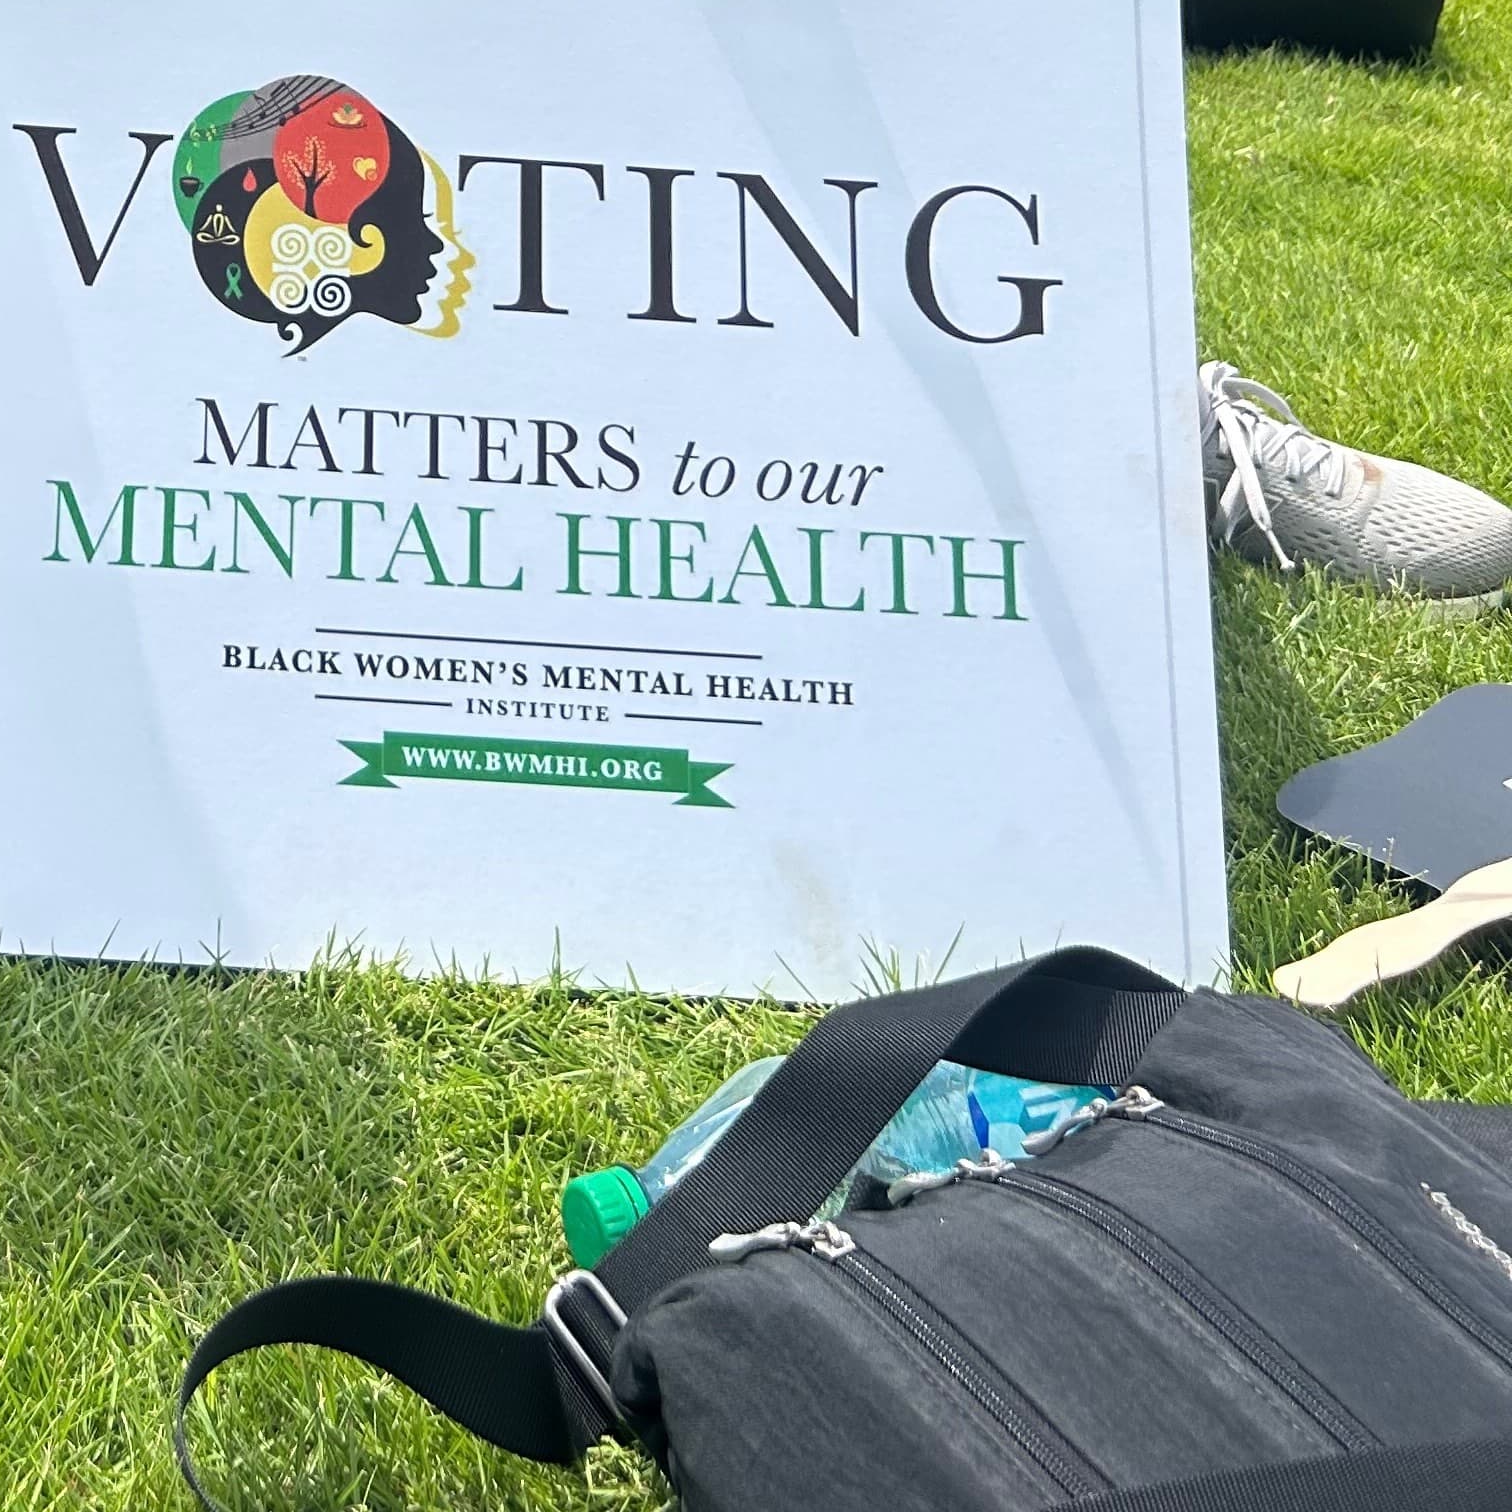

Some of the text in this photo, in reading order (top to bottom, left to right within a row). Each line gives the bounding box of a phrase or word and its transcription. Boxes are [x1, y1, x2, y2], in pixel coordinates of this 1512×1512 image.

[193, 397, 884, 507] MATTERS to our
[41, 479, 1029, 621] MENTAL HEALTH
[221, 643, 855, 707] BLACK WOMEN’S MENTAL HEALTH
[465, 697, 611, 723] INSTITUTE
[401, 746, 664, 782] WWW.BWMHI.ORG
